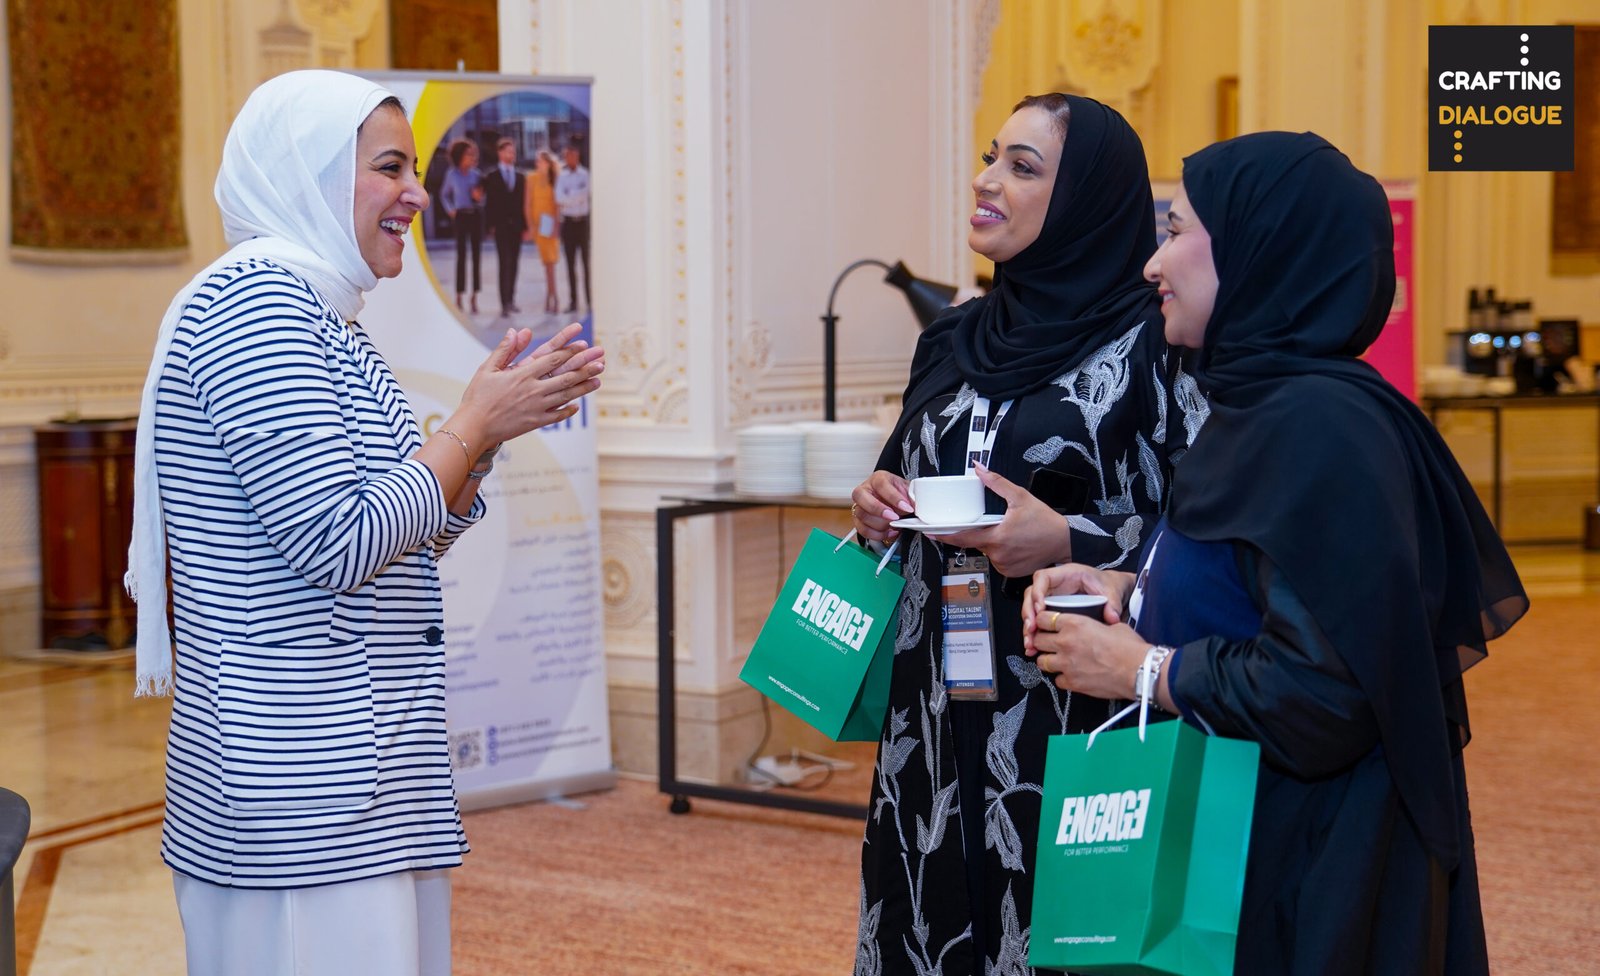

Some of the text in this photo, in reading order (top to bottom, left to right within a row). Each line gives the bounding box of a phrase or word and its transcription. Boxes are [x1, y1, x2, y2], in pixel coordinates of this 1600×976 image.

[791, 578, 874, 652] ENGAGE
[796, 618, 849, 655] FOR BETTER PERFORMANCE
[1055, 788, 1152, 845] ENGAGE
[1063, 844, 1129, 856] FOR BETTER PERFORMANCE
